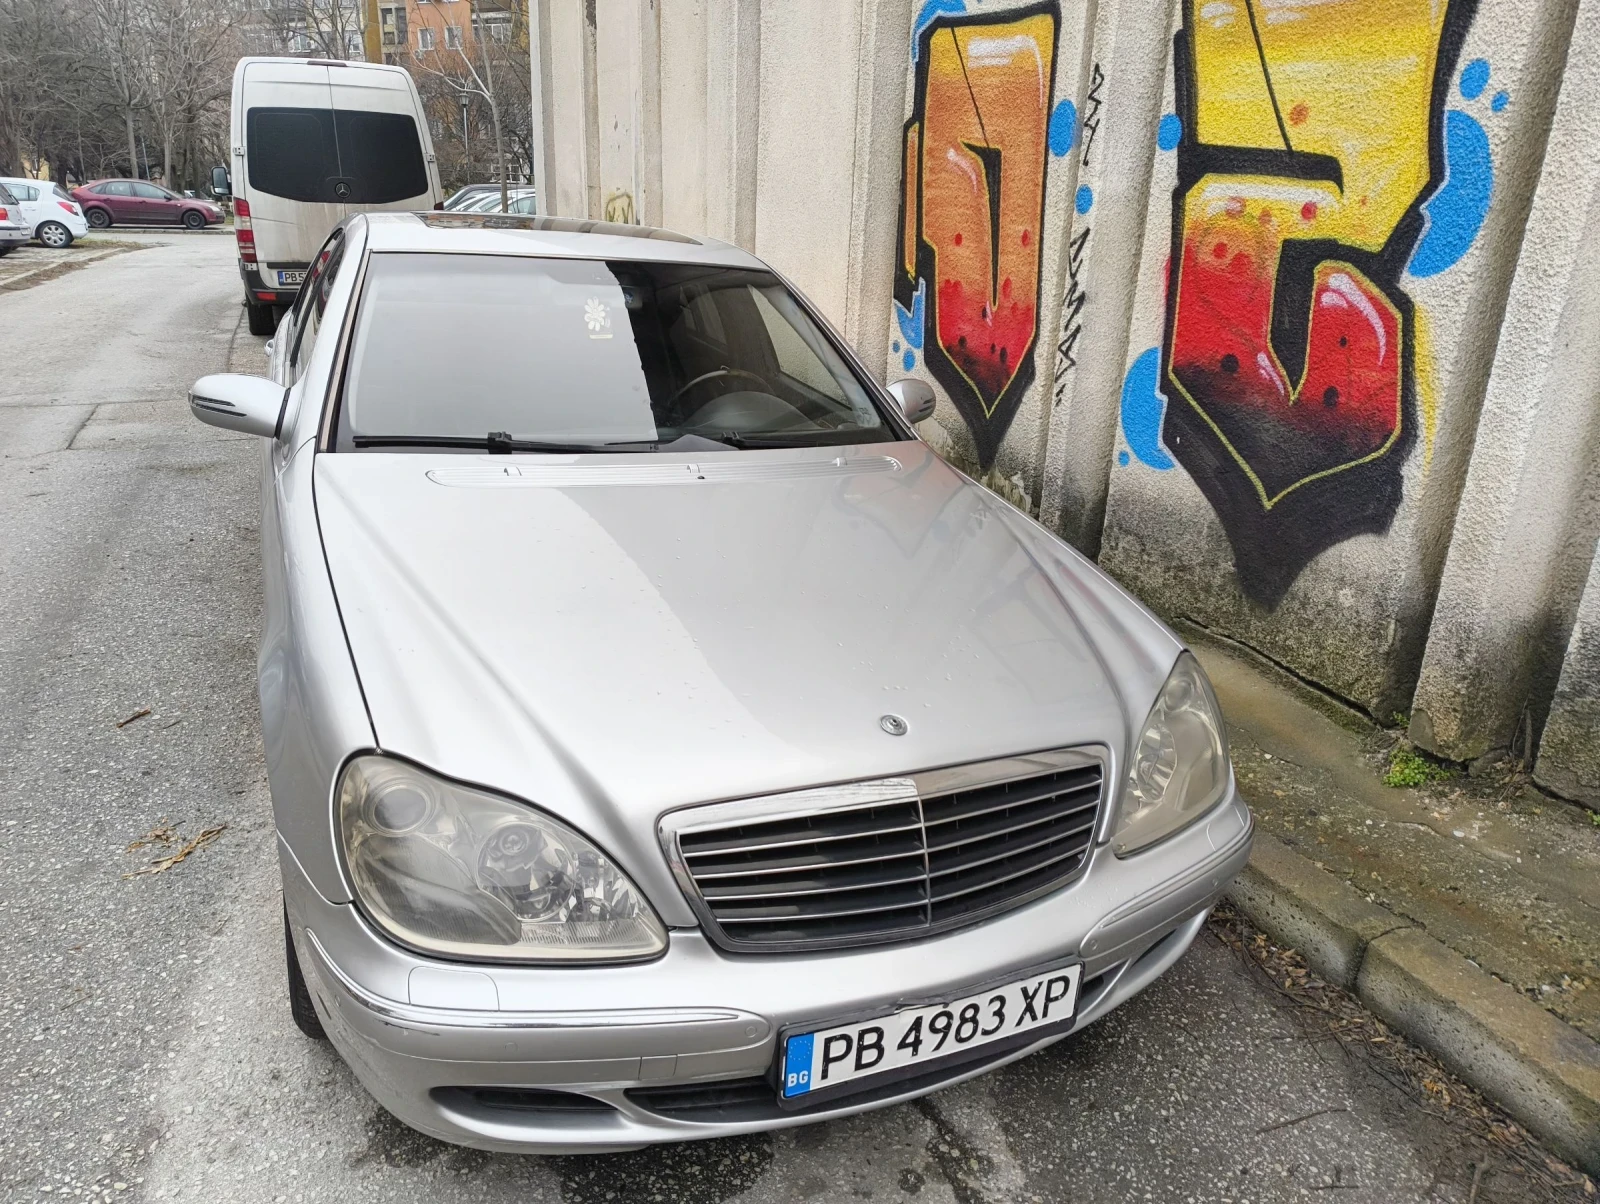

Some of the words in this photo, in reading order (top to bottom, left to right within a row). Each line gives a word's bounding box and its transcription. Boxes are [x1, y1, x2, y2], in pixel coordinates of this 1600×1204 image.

[284, 272, 297, 282] PB
[820, 1026, 884, 1080] PB
[897, 995, 1007, 1056] 4983
[1015, 975, 1070, 1027] XP
[787, 1070, 809, 1088] BG
